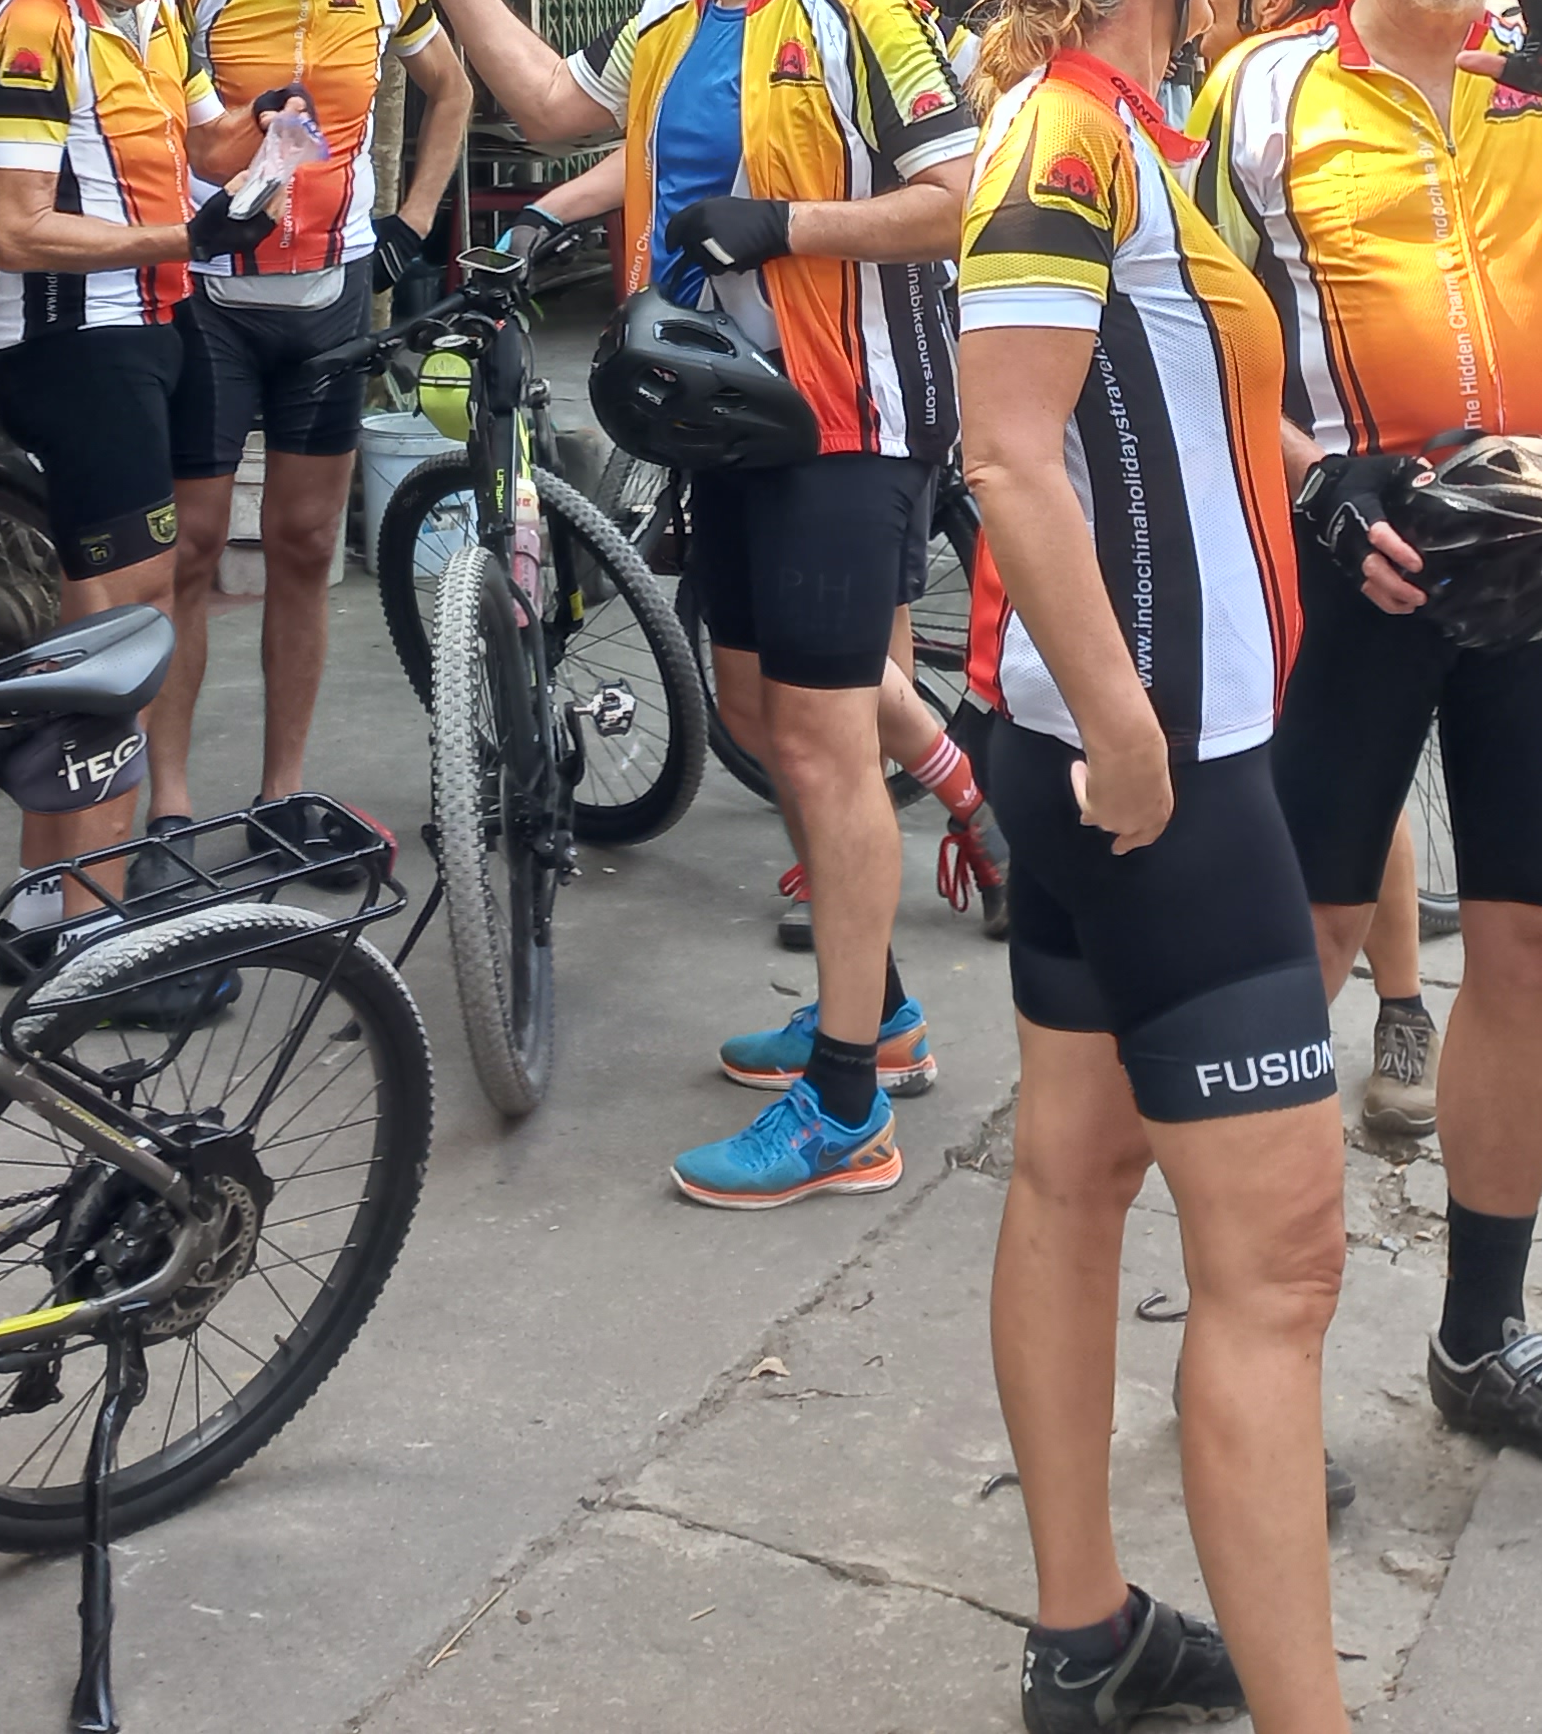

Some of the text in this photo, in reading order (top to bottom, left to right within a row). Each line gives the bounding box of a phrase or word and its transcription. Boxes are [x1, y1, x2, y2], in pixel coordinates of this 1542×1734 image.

[1111, 76, 1159, 124] GIANT
[1445, 275, 1468, 330] Charm
[907, 262, 938, 425] inabiketours.com
[1456, 332, 1477, 396] Hidden
[1195, 1037, 1335, 1098] FUSION
